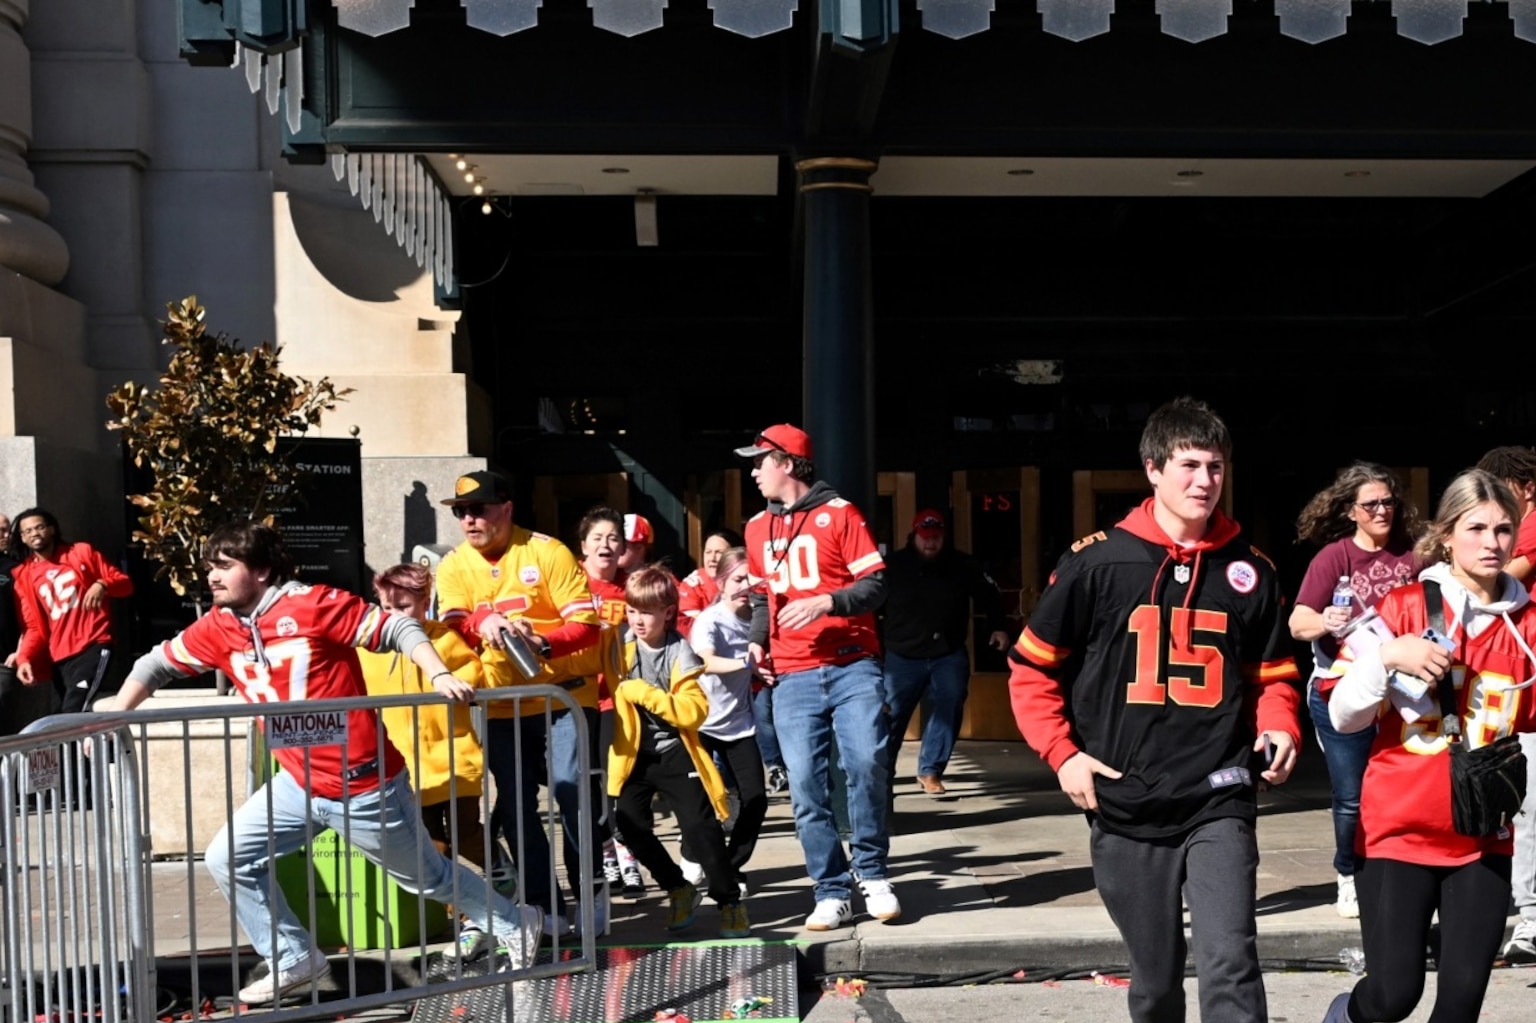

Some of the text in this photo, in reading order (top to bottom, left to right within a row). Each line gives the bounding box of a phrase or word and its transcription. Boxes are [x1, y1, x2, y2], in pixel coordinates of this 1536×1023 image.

[39, 569, 81, 621] 15
[763, 534, 821, 595] 50
[229, 636, 313, 705] 87
[1126, 604, 1228, 708] 15
[271, 713, 345, 734] NATIONAL
